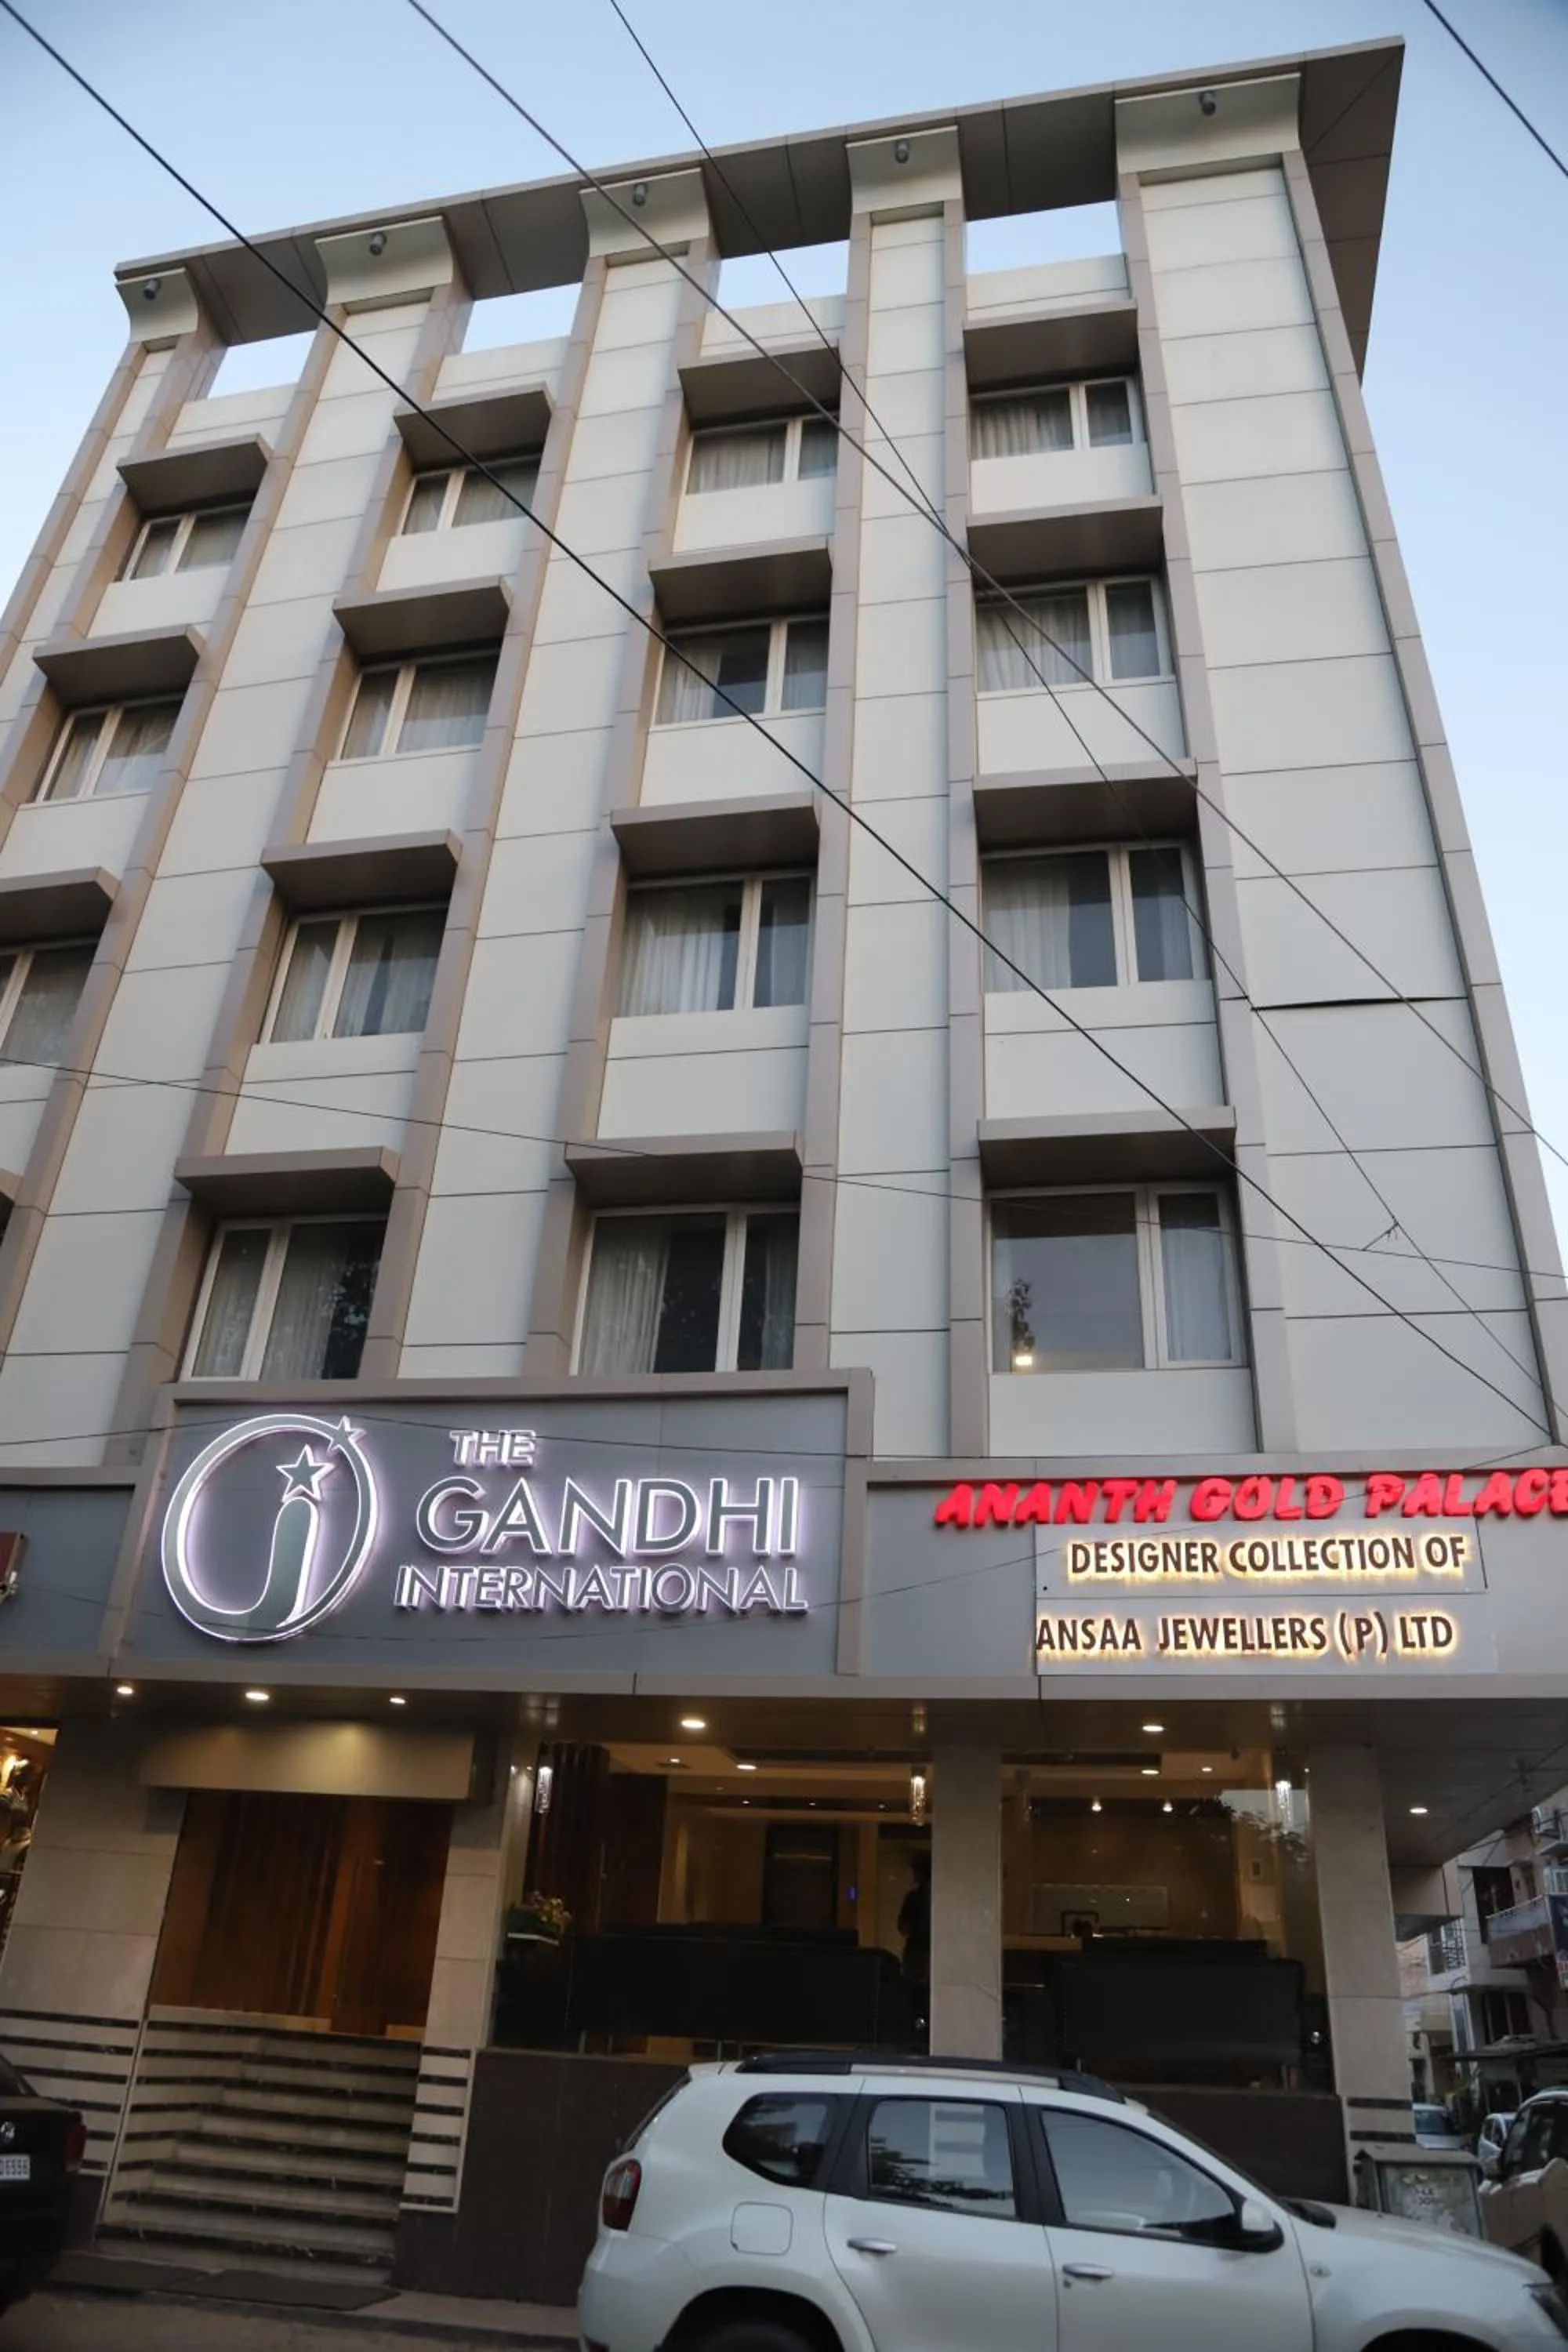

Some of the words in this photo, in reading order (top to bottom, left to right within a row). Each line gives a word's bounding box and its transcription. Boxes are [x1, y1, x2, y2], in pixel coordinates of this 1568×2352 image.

[449, 1428, 536, 1466] THE
[416, 1474, 799, 1556] GANDHI
[934, 1478, 1176, 1529] ANANTH
[1190, 1474, 1345, 1523] GOLD
[1071, 1541, 1219, 1574] DESIGNER
[1229, 1536, 1414, 1573] COLLECTION
[1424, 1535, 1466, 1569] OF
[394, 1563, 811, 1613] INTERNATIONAL
[1036, 1618, 1142, 1652] ANSAA
[1157, 1617, 1327, 1651] JEWELLERS
[1338, 1610, 1388, 1654] (P)
[1399, 1615, 1454, 1649] LTD
